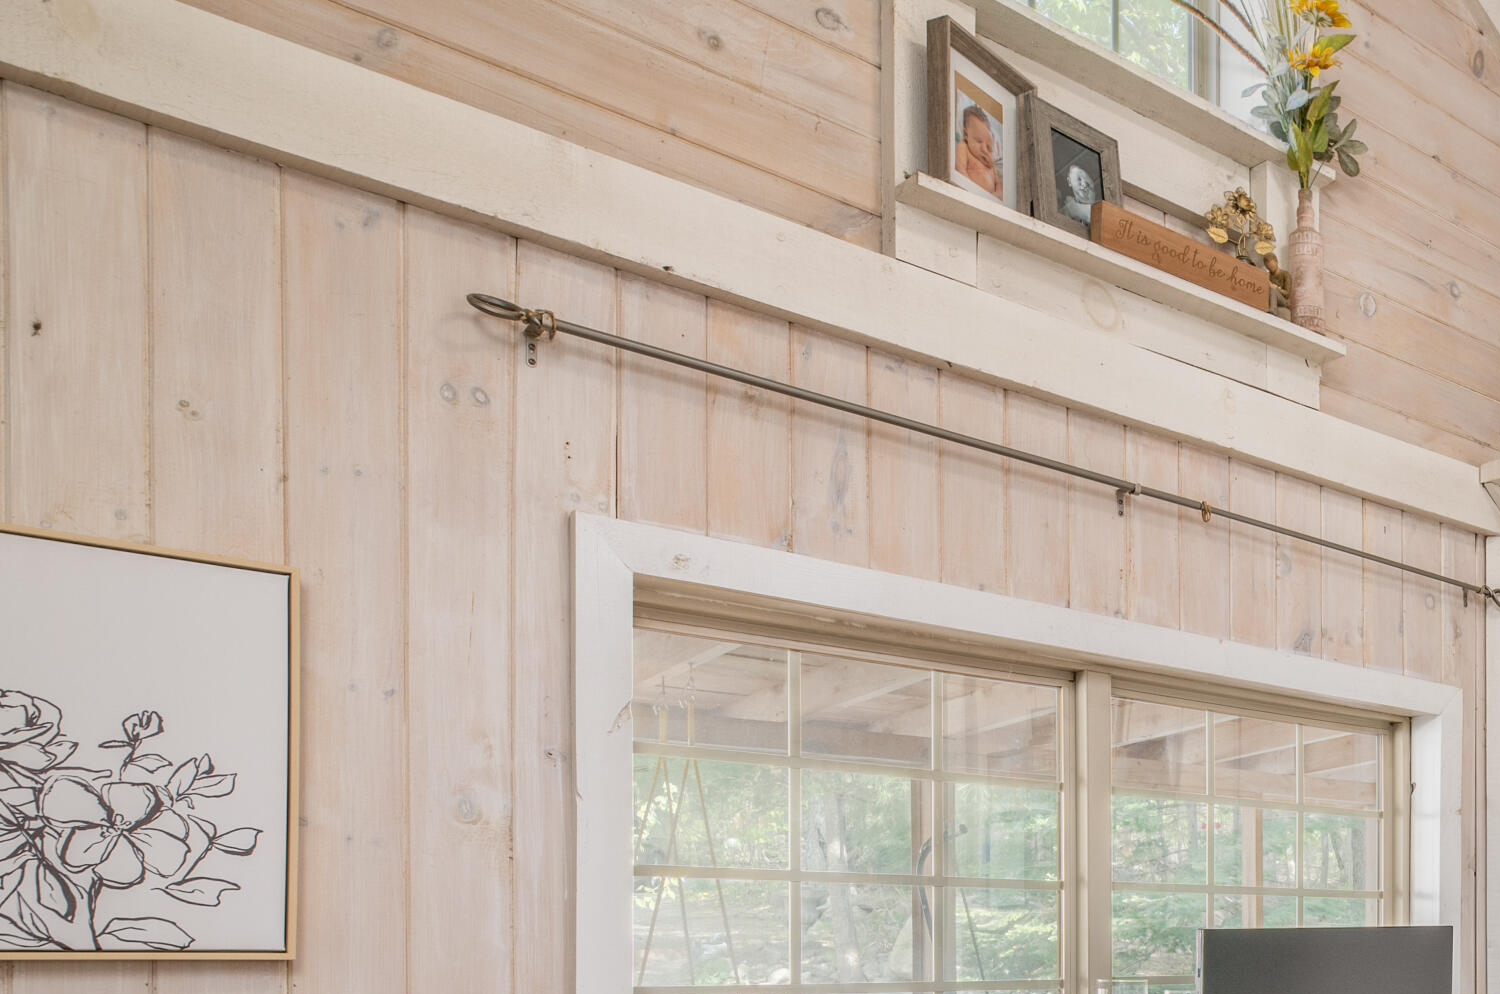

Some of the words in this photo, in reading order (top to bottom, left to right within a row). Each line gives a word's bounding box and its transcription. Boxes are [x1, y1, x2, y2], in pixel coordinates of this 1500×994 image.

[1115, 218, 1135, 240] It
[1136, 230, 1150, 246] is
[1152, 240, 1190, 263] good
[1191, 248, 1207, 270] to
[1208, 257, 1226, 278] be
[1227, 265, 1265, 294] home
